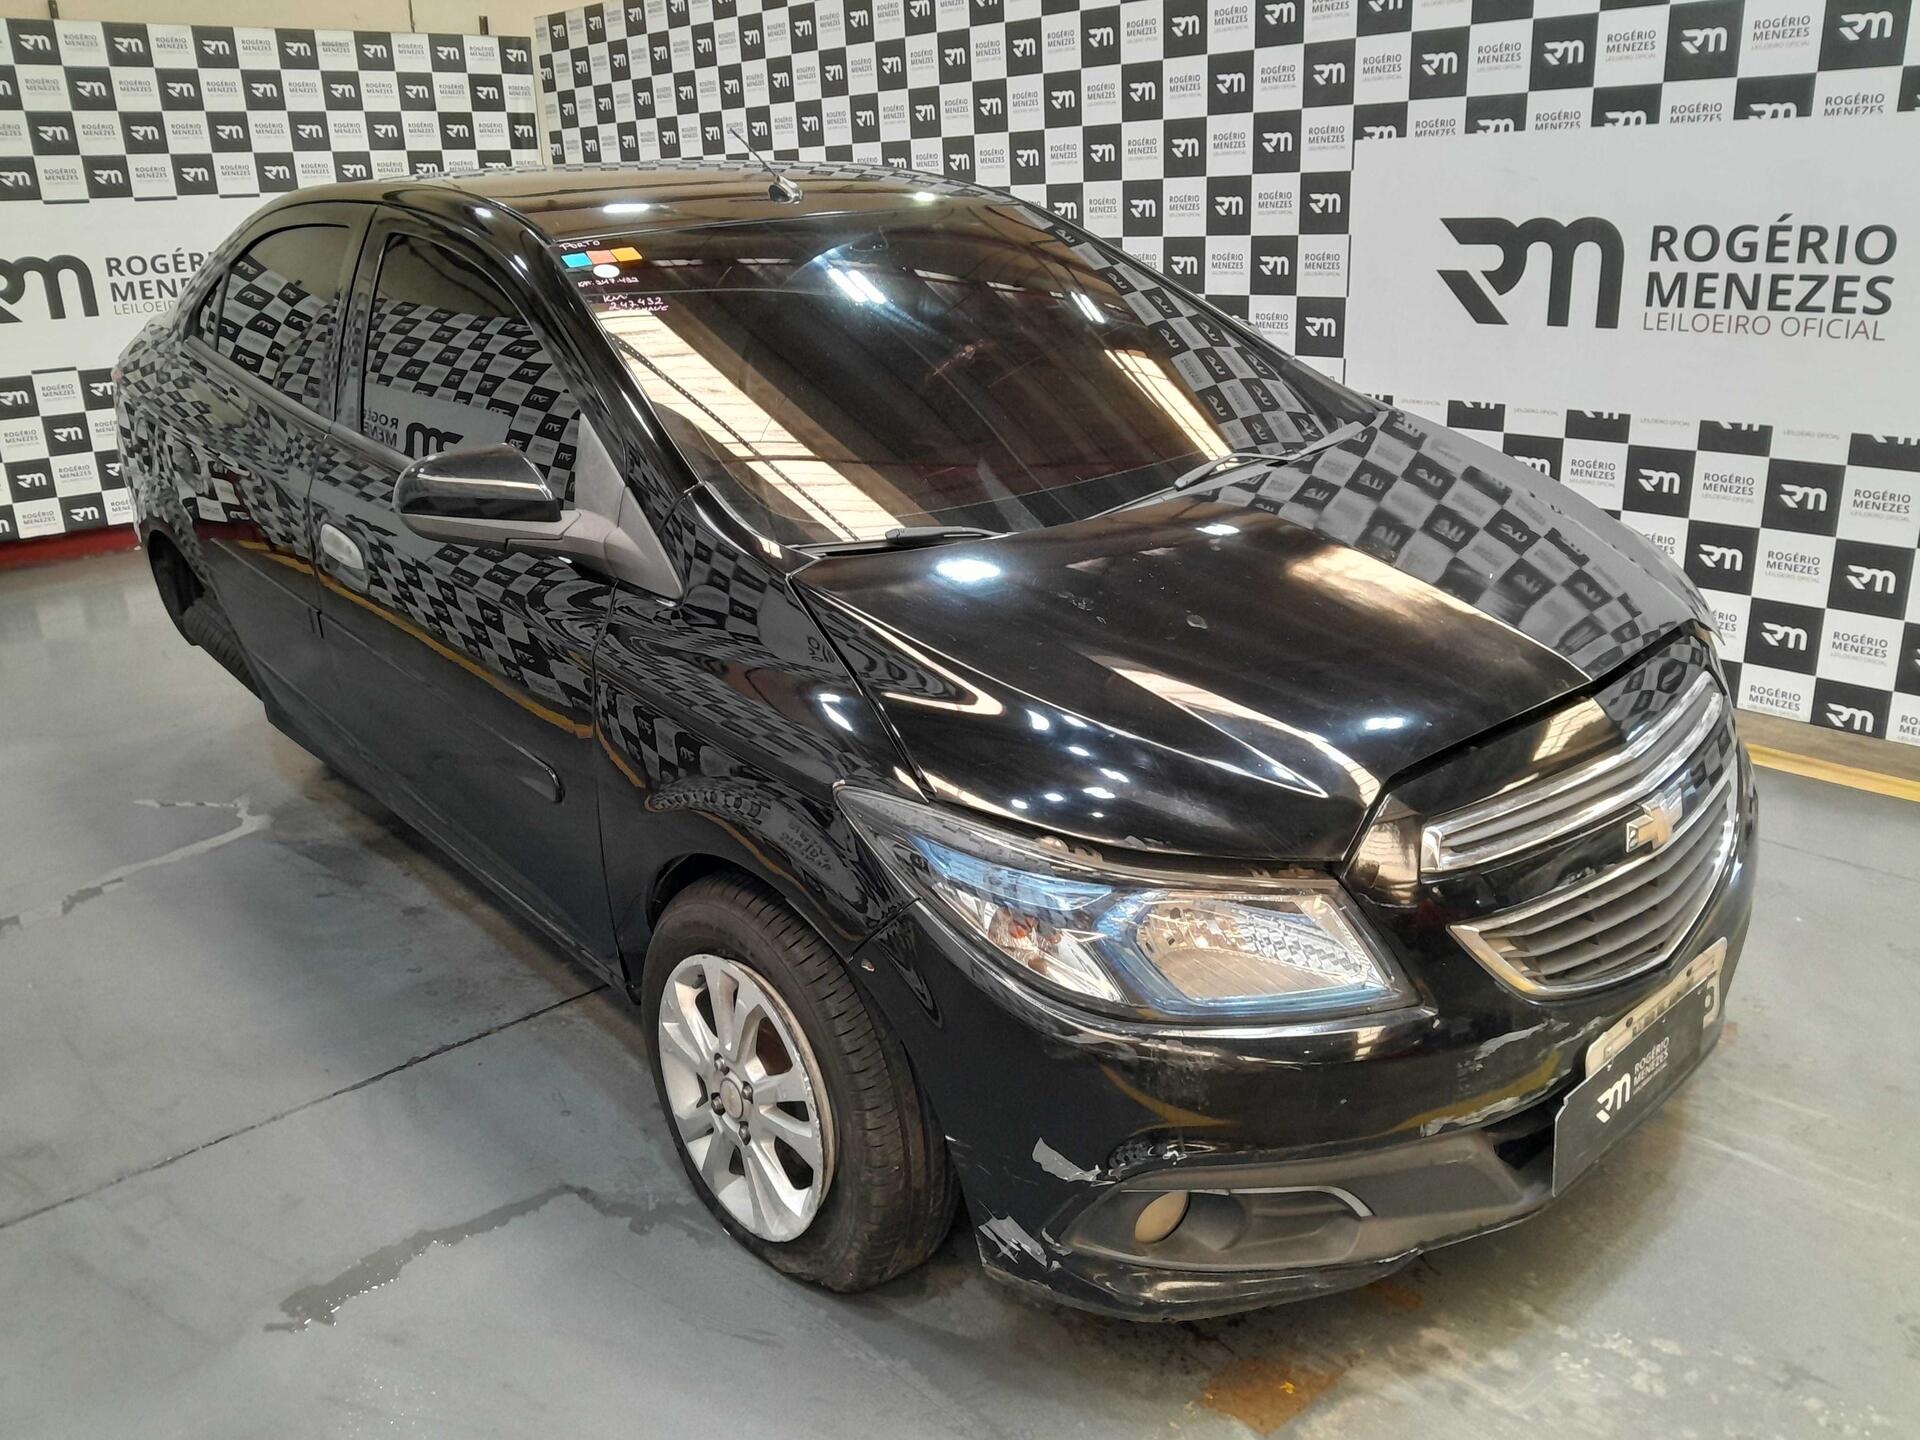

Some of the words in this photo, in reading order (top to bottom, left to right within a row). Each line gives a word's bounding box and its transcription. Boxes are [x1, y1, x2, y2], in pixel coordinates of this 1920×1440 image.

[1214, 6, 1248, 17] ROGÉRIO
[1312, 1, 1349, 13] MENEZES
[1127, 18, 1156, 29] ROGÉRIO
[1214, 14, 1248, 26] MENEZES
[1754, 16, 1810, 30] ROGÉRIO
[1048, 30, 1074, 39] ROGÉRIO
[1127, 26, 1157, 37] MENEZES
[1753, 27, 1809, 41] MENEZES
[1048, 37, 1075, 47] MENEZES
[1607, 30, 1656, 45] ROGÉRIO
[1478, 42, 1521, 54] ROGÉRIO
[1606, 40, 1655, 54] MENEZES
[1363, 54, 1402, 65] ROGÉRIO
[1477, 52, 1521, 64] MENEZES
[1261, 64, 1296, 75] ROGÉRIO
[1363, 64, 1401, 74] MENEZES
[1170, 74, 1200, 84] ROGÉRIO
[1261, 74, 1295, 84] MENEZES
[1087, 82, 1115, 94] ROGÉRIO
[1170, 82, 1200, 92] MENEZES
[1012, 91, 1038, 101] ROGÉRIO
[1088, 91, 1116, 100] MENEZES
[1825, 92, 1884, 106] ROGÉRIO
[1013, 98, 1038, 107] MENEZES
[1671, 102, 1722, 114] ROGÉRIO
[1536, 110, 1581, 122] ROGÉRIO
[1416, 118, 1456, 129] ROGÉRIO
[1309, 125, 1344, 135] ROGÉRIO
[1128, 137, 1157, 147] ROGÉRIO
[1213, 132, 1246, 142] ROGÉRIO
[1308, 134, 1344, 144] MENEZES
[1050, 143, 1077, 152] ROGÉRIO
[1128, 146, 1157, 154] MENEZES
[1213, 140, 1246, 150] MENEZES
[1051, 152, 1077, 160] MENEZES
[1169, 194, 1200, 203] ROGÉRIO
[1258, 190, 1292, 200] ROGÉRIO
[1089, 197, 1116, 207] ROGÉRIO
[1258, 200, 1292, 208] MENEZES
[1649, 213, 1898, 265] ROGÉRIO
[105, 247, 212, 277] ROGÉR
[1212, 252, 1243, 261] ROGÉRIO
[1305, 252, 1340, 262] ROGÉRIO
[1644, 271, 1894, 316] MENEZES
[1256, 312, 1288, 322] ROGÉRIO
[1642, 312, 1771, 336] LEILOEIRO
[1780, 318, 1886, 342] OFICIAL
[1571, 459, 1616, 472] ROGÉRIO
[1570, 468, 1615, 480] MENEZES
[1704, 472, 1754, 487] ROGÉRIO
[1703, 482, 1754, 496] MENEZES
[1854, 489, 1911, 503] ROGÉRIO
[1853, 499, 1910, 514] MENEZES
[1768, 551, 1820, 566] ROGÉRIO
[1766, 560, 1819, 575] MENEZES
[1833, 632, 1888, 648] ROGÉRIO
[1832, 641, 1887, 658] MENEZES
[1750, 685, 1801, 702] ROGÉRIO
[1749, 694, 1800, 711] MENEZES
[1634, 1036, 1670, 1074] ROGÉRIO
[1634, 1050, 1669, 1086] MENEZES
